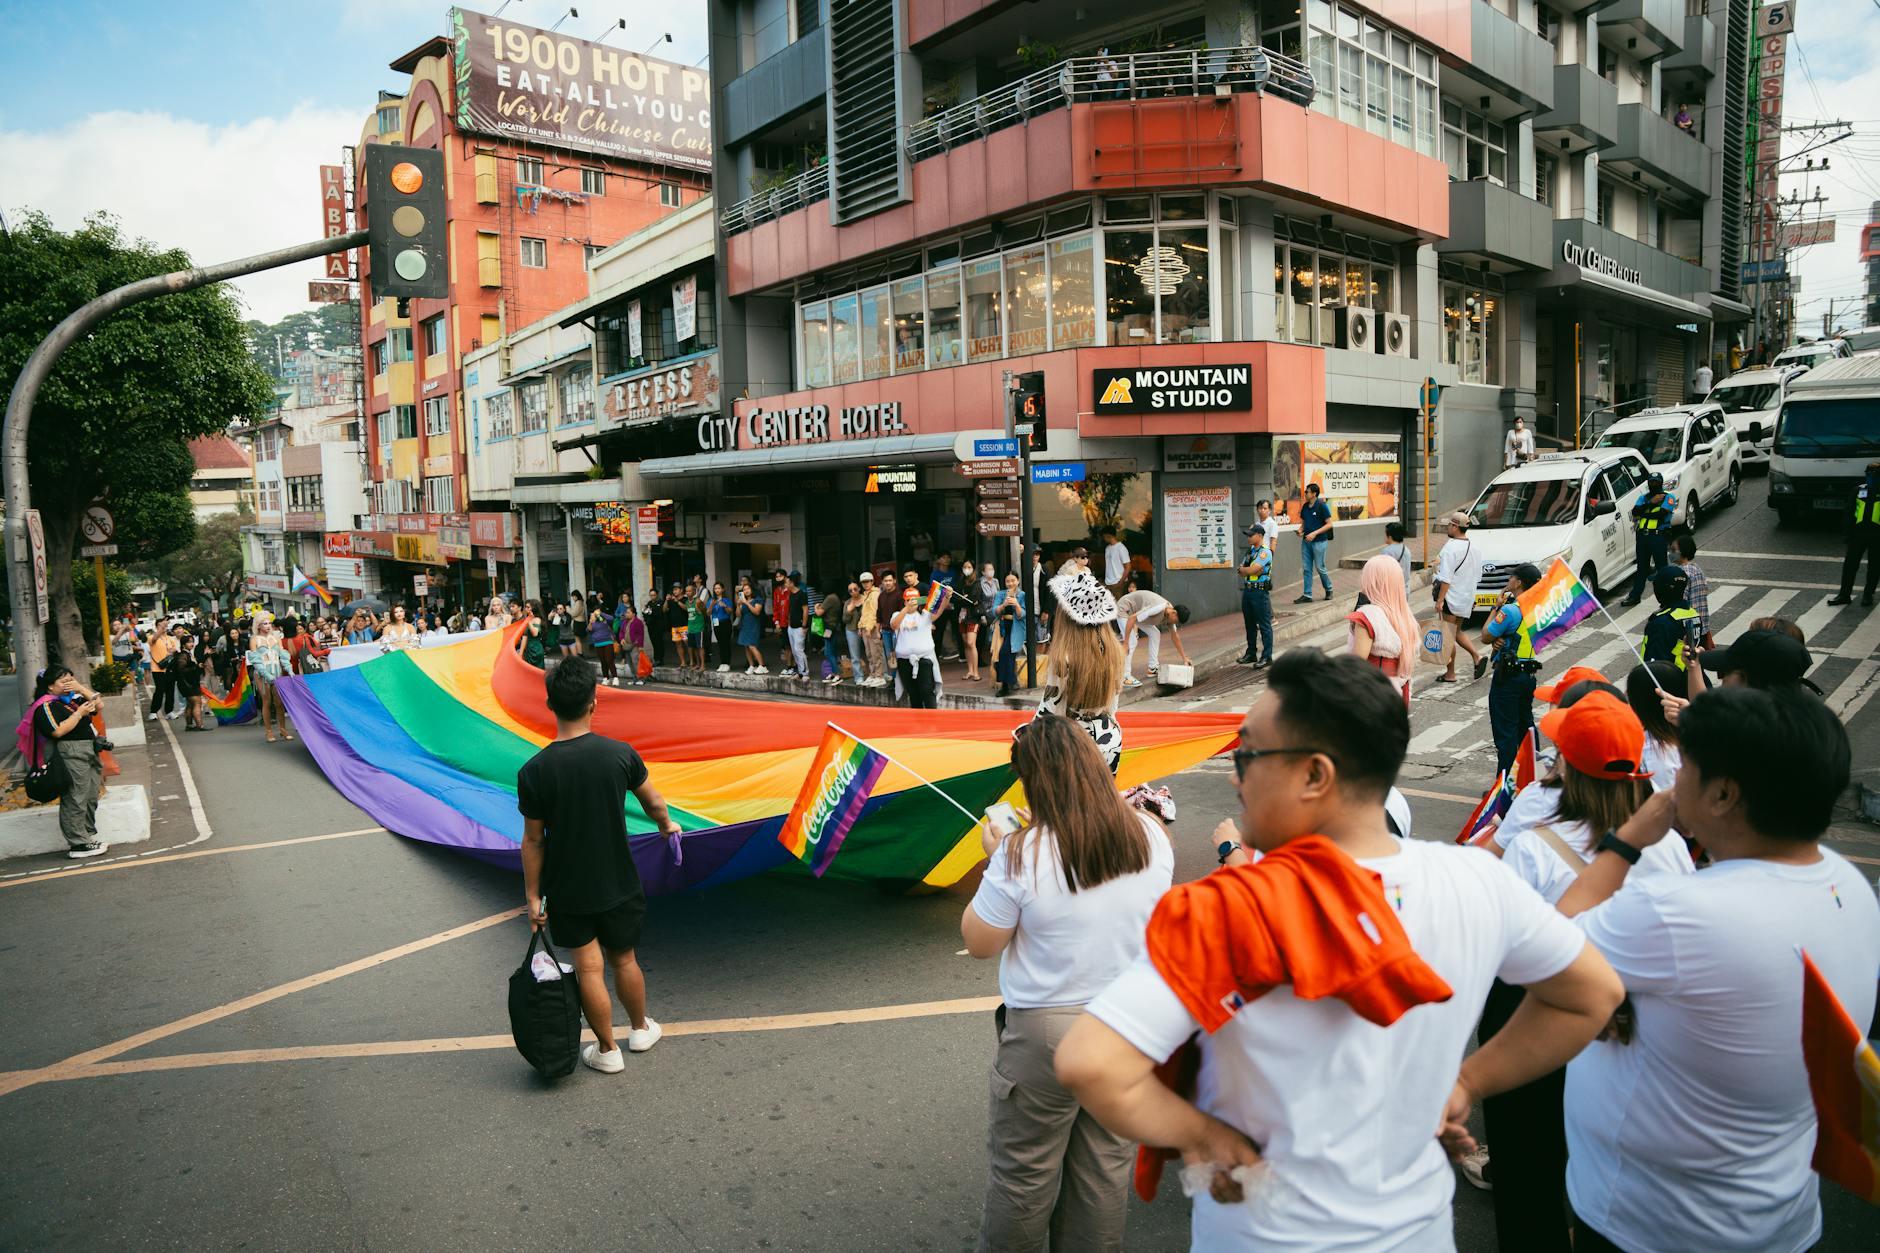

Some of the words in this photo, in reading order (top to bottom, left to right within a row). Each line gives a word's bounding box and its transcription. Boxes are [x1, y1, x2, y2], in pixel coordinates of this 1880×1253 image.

[1768, 7, 1784, 25] 5
[486, 25, 581, 76] 1900
[592, 47, 670, 96] HOT
[682, 69, 711, 105] P
[497, 91, 569, 124] World
[578, 109, 664, 143] Chinese
[497, 121, 528, 133] LOCATED
[538, 128, 555, 137] UNIT
[596, 139, 621, 151] VALLEJO
[655, 150, 673, 160] UPPER
[673, 153, 696, 164] SESSION
[696, 157, 712, 166] ROAD
[1617, 264, 1642, 286] HOTEL
[969, 335, 1002, 357] LIGHT
[1009, 331, 1047, 350] HOUSE
[1054, 319, 1096, 346] LAMPS
[896, 350, 926, 369] LAMPS
[1135, 368, 1248, 389] MOUNTAIN
[614, 367, 694, 412] RECESS
[1151, 389, 1233, 408] STUDIO
[839, 401, 905, 435] HOTEL
[978, 443, 1004, 452] SESSION
[1005, 442, 1017, 451] RD.
[1167, 452, 1233, 461] MOUNTAIN
[1035, 469, 1060, 478] MABINI
[1062, 468, 1073, 477] ST.
[1177, 461, 1222, 470] STUDIO
[878, 471, 917, 483] MOUNTAIN
[1324, 471, 1367, 480] MOUNTAIN
[892, 483, 917, 493] STUDIO
[1331, 481, 1360, 490] STUDIO
[1172, 496, 1198, 504] SPECIAL
[571, 507, 594, 519] JAMES
[594, 507, 621, 519] WRIGHT
[999, 523, 1019, 531] MARKET
